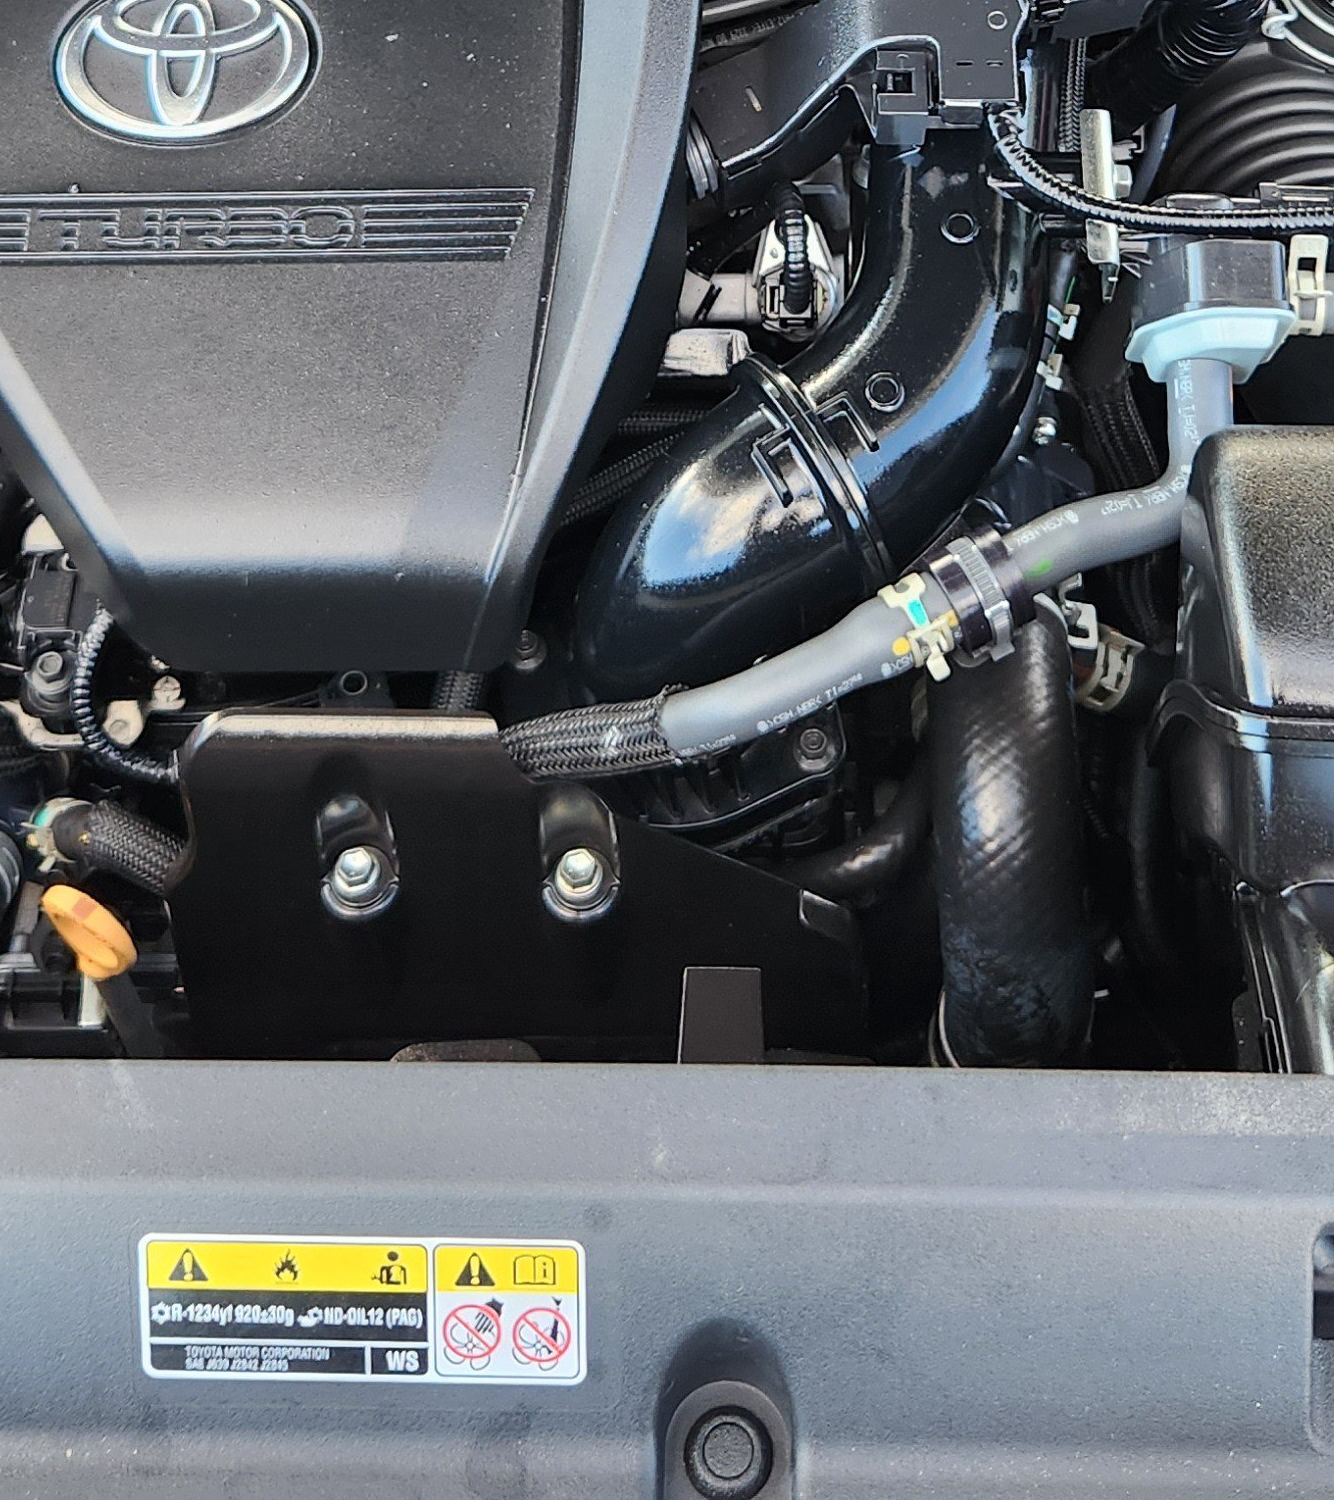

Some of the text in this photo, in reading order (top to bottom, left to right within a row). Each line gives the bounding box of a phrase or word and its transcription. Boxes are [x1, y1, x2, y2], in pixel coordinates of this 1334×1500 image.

[38, 204, 354, 250] TURBO
[386, 1308, 423, 1329] (PAG)
[184, 1345, 330, 1361] TOYOTA MOTOR CORPORATION
[385, 1350, 420, 1372] WS
